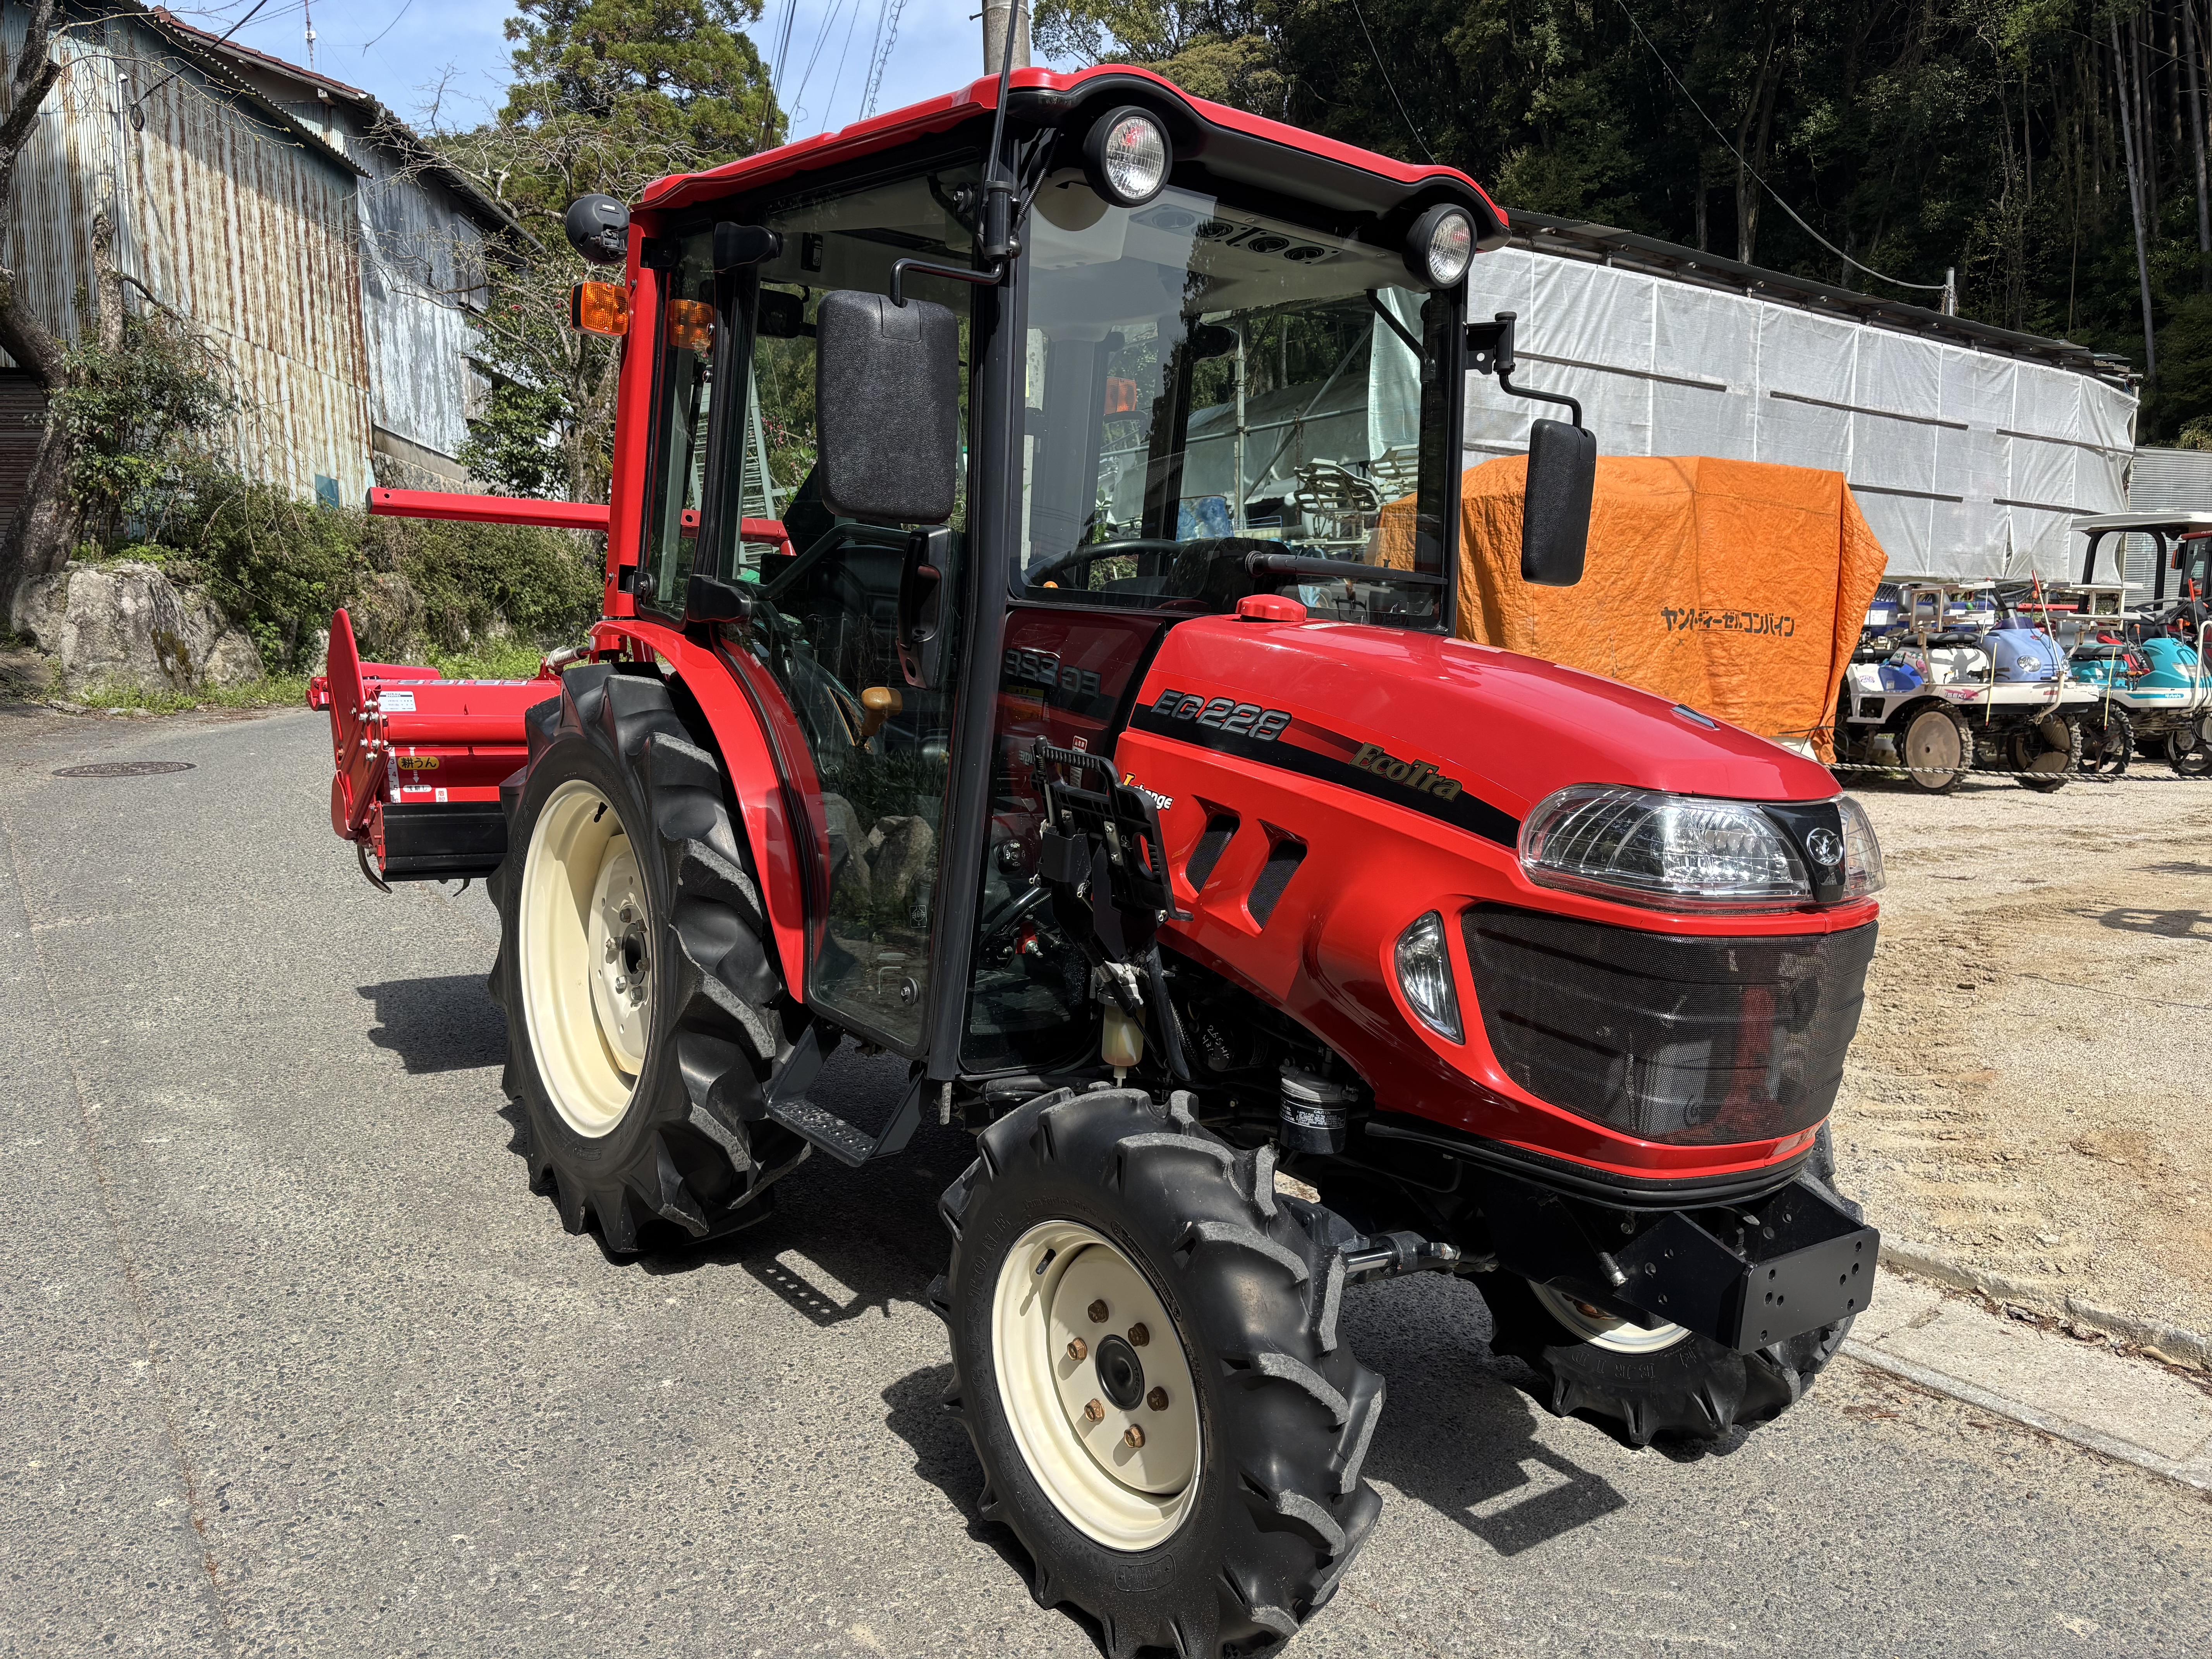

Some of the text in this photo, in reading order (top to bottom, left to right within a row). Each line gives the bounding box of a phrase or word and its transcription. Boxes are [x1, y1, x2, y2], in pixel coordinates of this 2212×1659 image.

[1150, 689, 1293, 742] EG228
[401, 757, 436, 768] 耕うん
[1348, 741, 1463, 802] EcoTra
